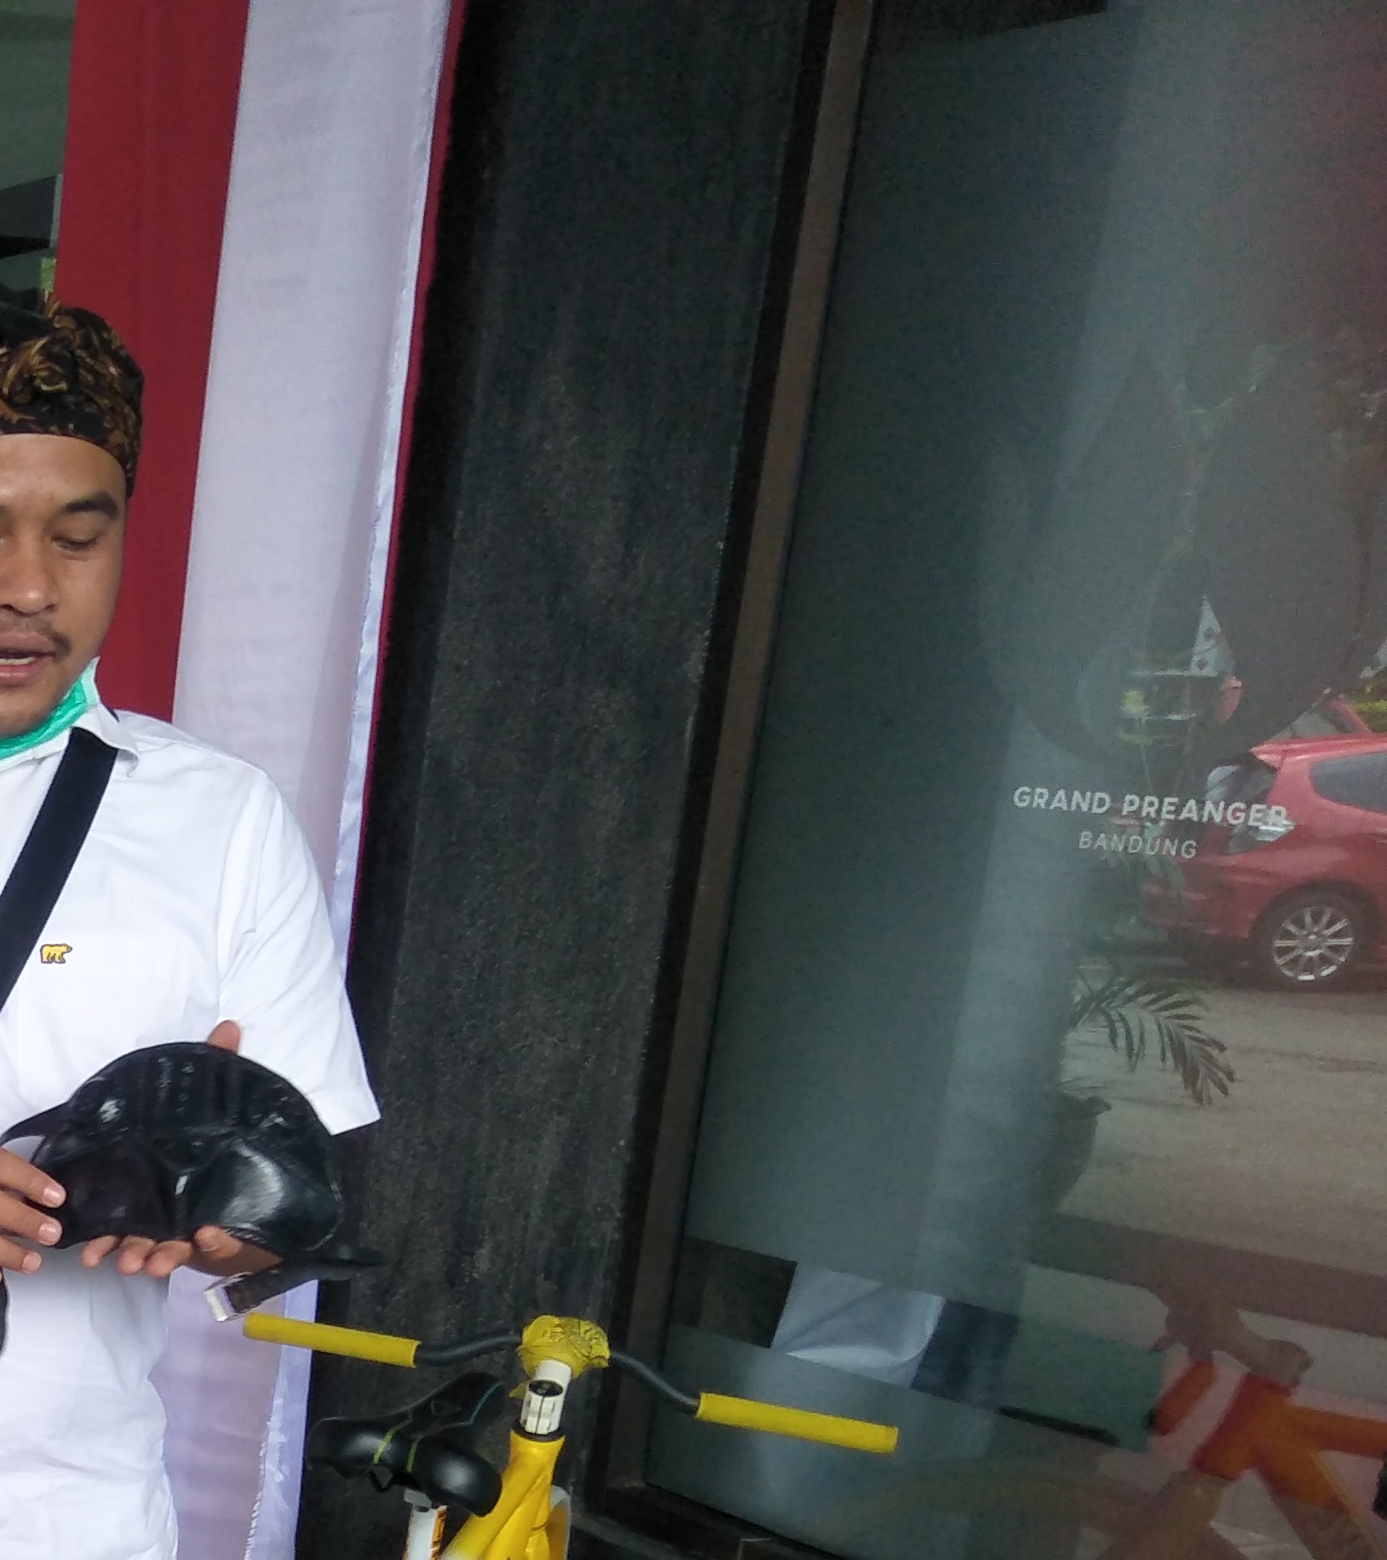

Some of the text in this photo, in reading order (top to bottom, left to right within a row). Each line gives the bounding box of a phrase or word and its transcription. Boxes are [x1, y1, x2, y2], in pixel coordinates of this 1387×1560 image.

[1012, 786, 1288, 828] GRAND PREANGER
[1079, 831, 1198, 860] BANDUNG
